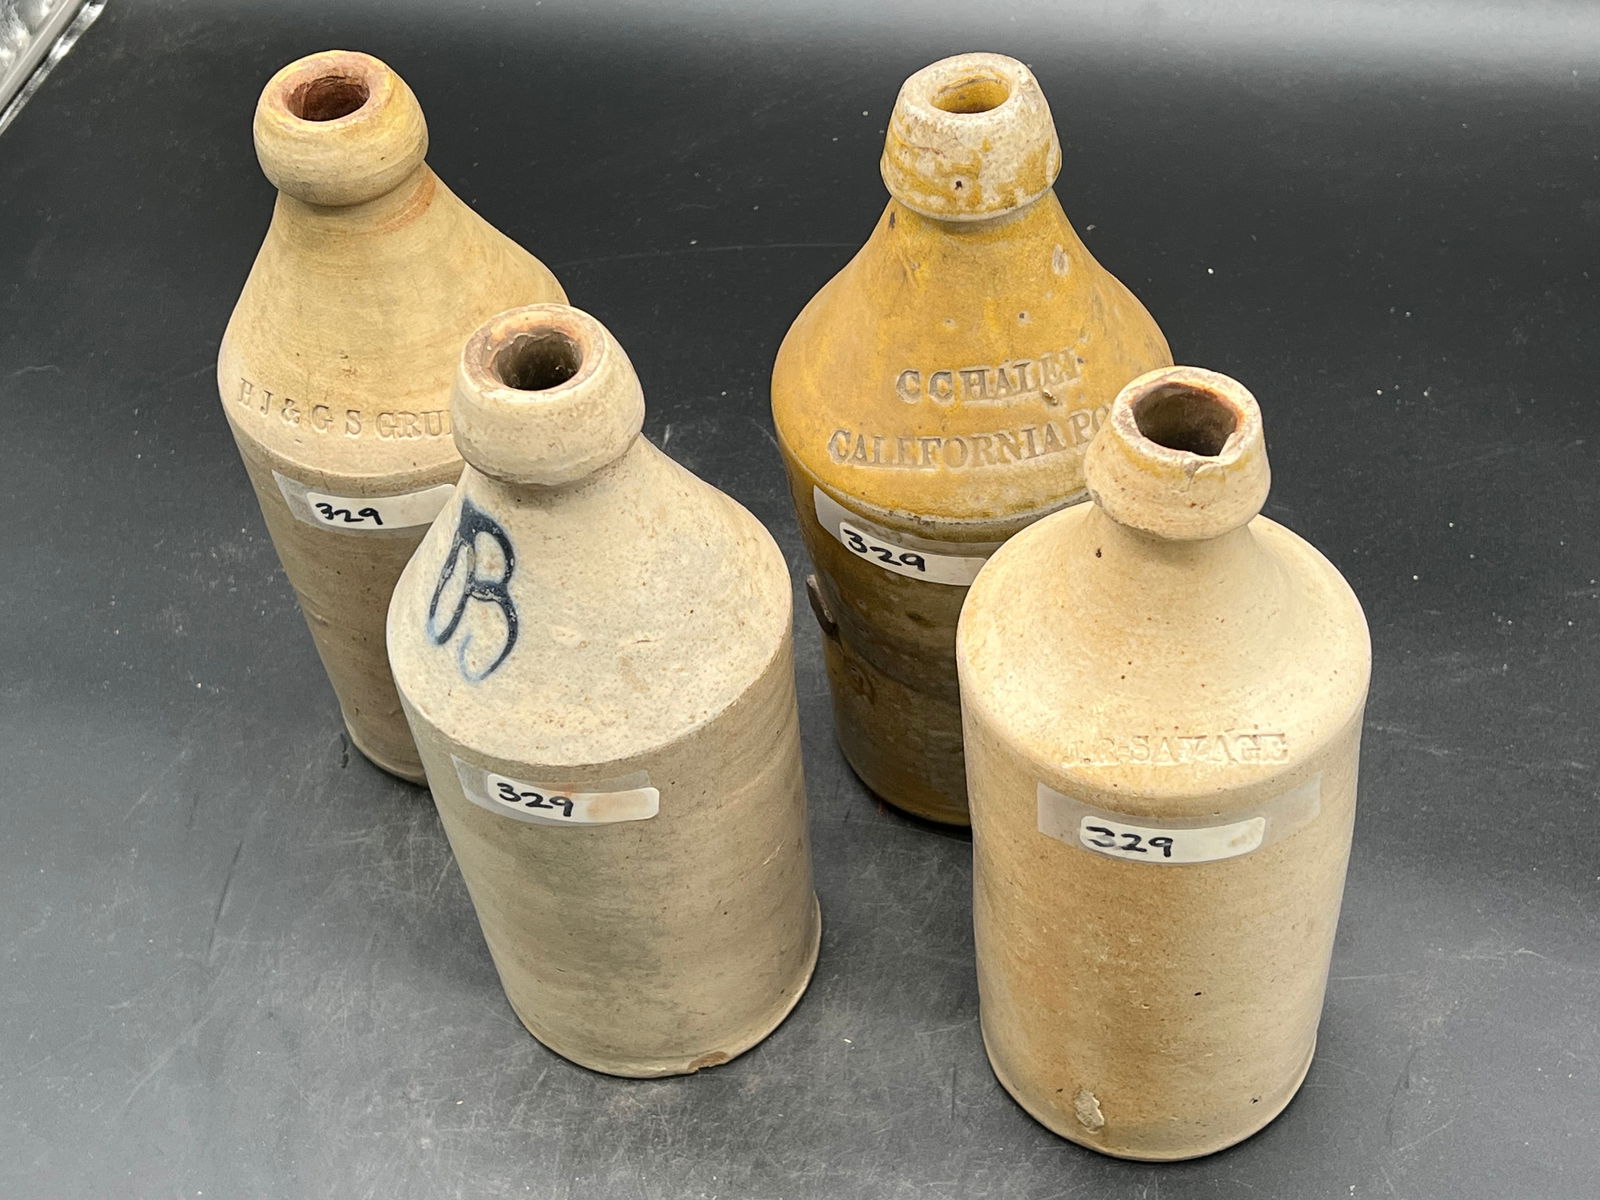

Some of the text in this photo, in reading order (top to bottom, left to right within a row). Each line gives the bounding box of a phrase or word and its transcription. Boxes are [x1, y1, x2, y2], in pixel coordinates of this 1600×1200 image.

[896, 368, 921, 403] C
[281, 398, 301, 425] &
[311, 405, 335, 434] G
[345, 409, 363, 436] S
[315, 503, 384, 526] 329
[843, 528, 926, 572] 329
[496, 782, 574, 817] 329
[1086, 826, 1173, 858] 329
